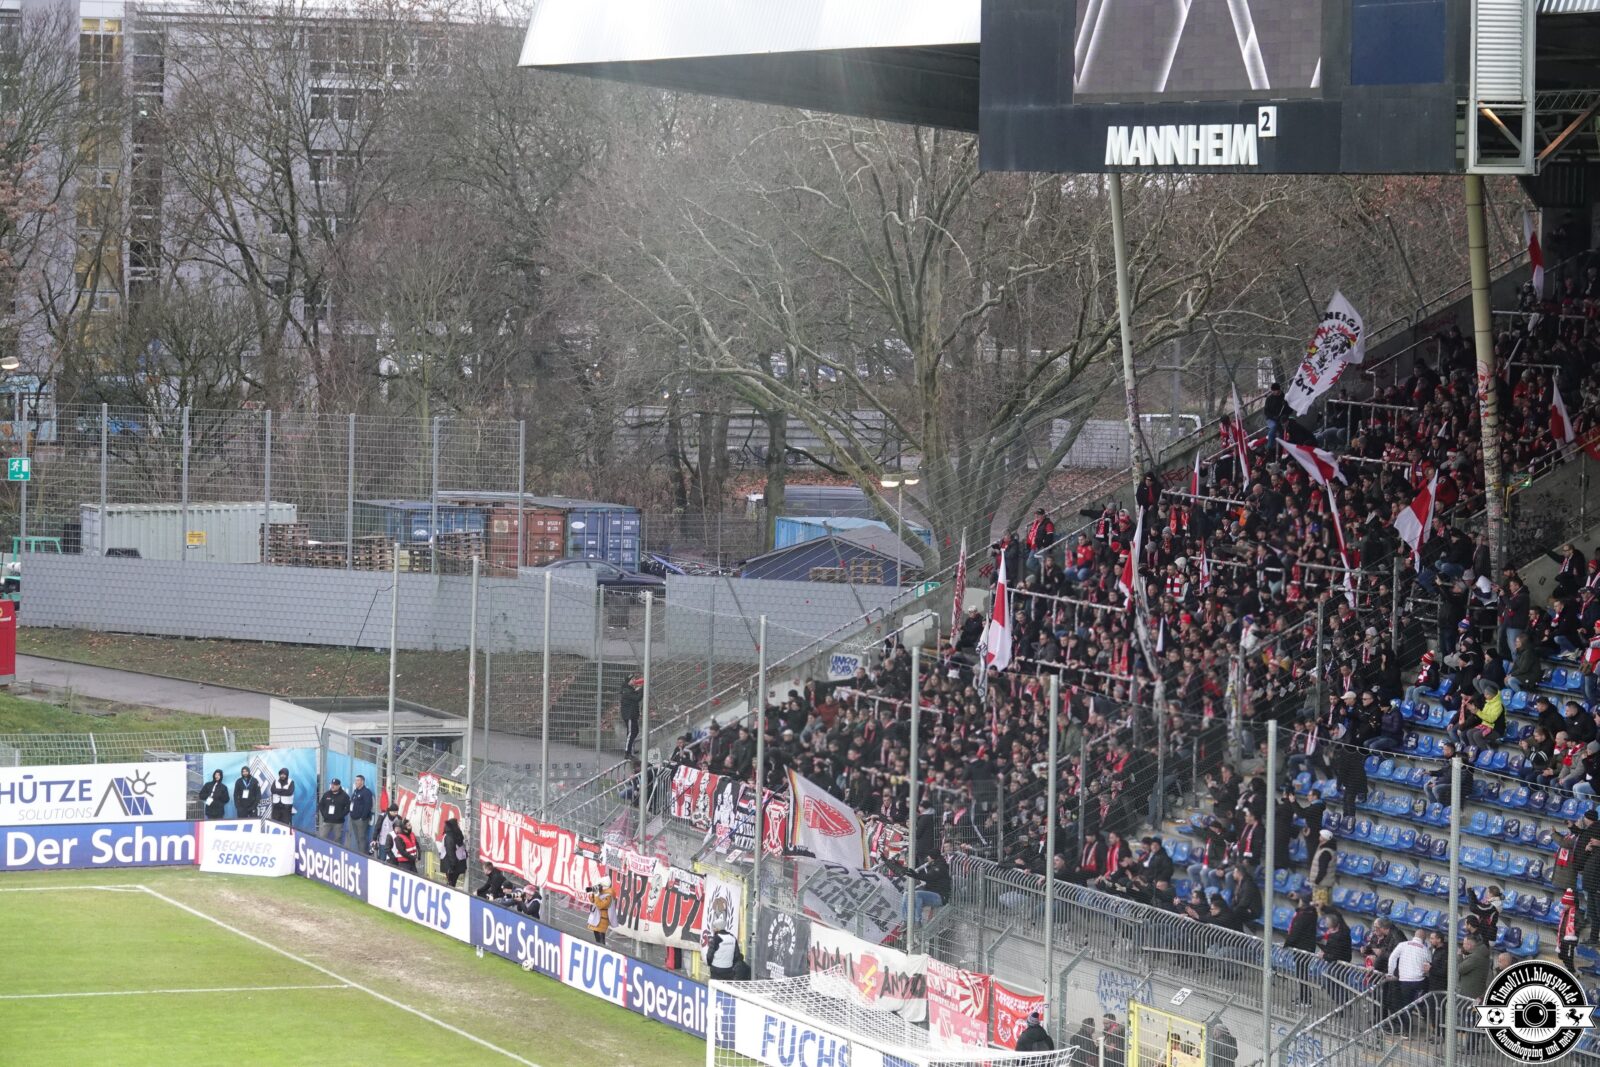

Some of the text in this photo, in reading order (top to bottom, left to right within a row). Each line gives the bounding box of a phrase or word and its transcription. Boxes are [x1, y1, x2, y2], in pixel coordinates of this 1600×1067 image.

[1105, 124, 1258, 166] MANNHEIM
[18, 807, 93, 821] SOLUTIONS
[6, 826, 196, 867] Der Schm
[212, 839, 273, 856] RECHNER
[217, 853, 277, 869] SENSORS
[295, 837, 362, 896] -Spezialist
[388, 871, 452, 930] FUCHS
[482, 907, 561, 976] Der Schm
